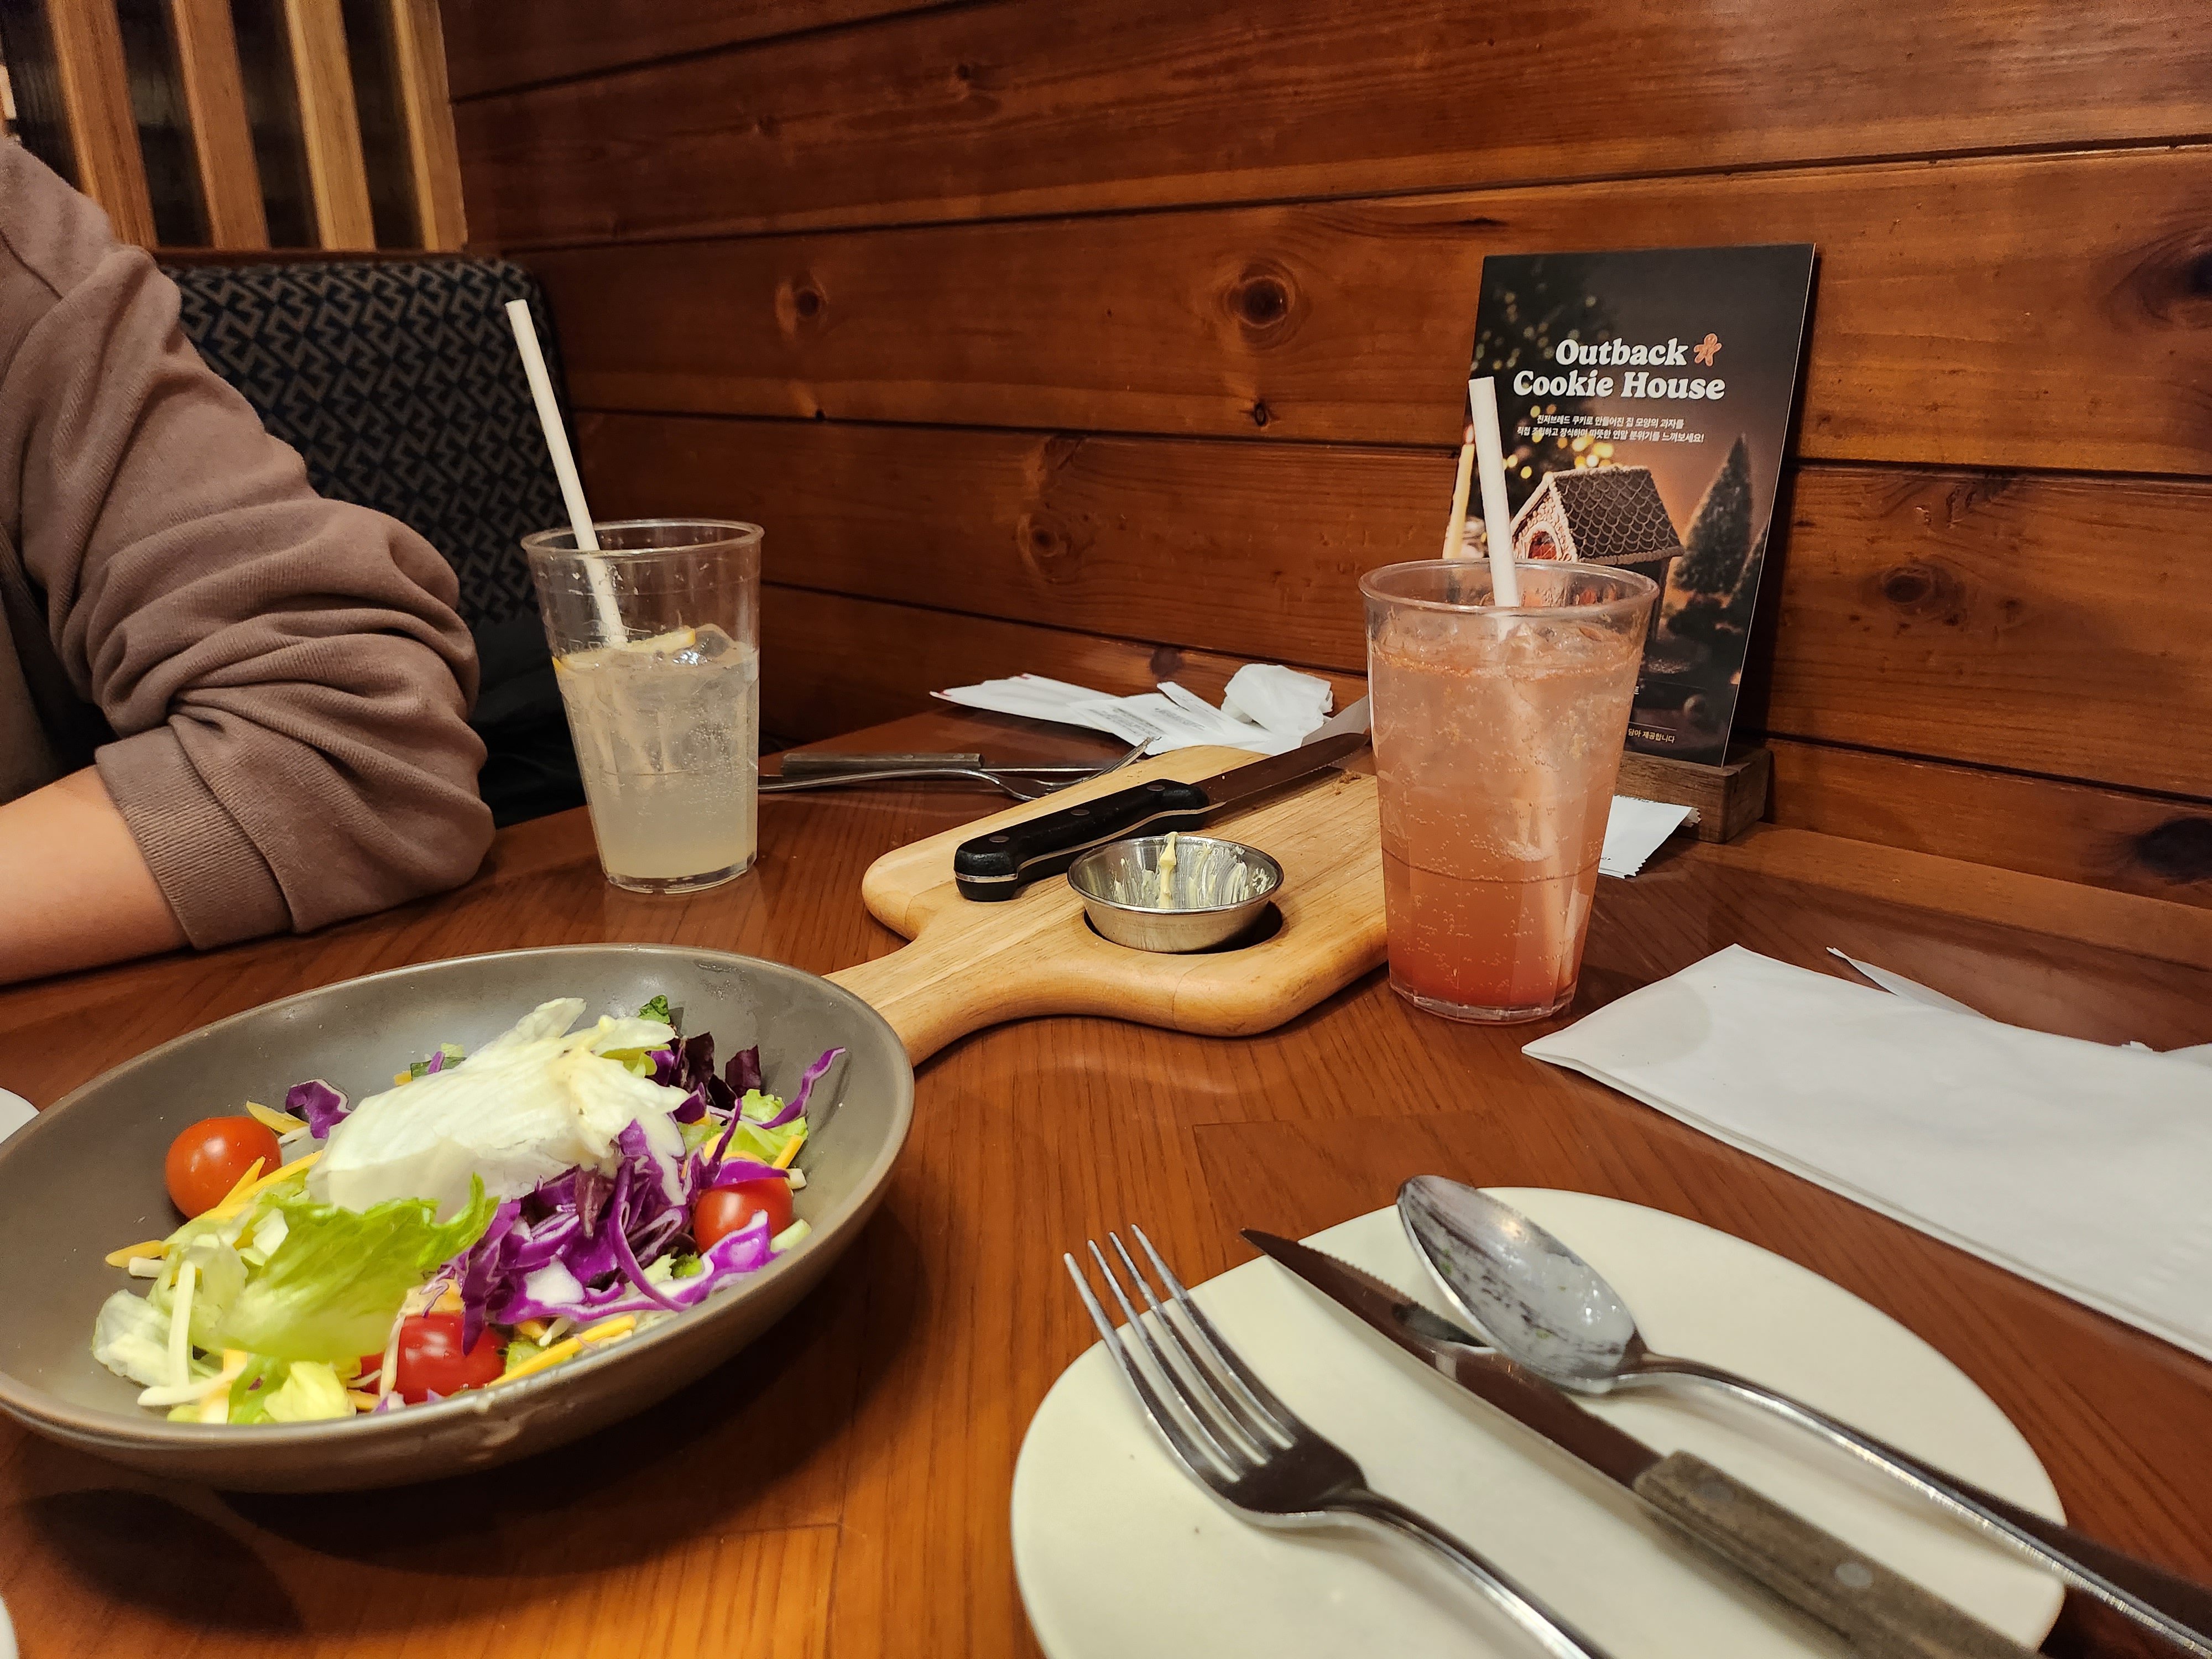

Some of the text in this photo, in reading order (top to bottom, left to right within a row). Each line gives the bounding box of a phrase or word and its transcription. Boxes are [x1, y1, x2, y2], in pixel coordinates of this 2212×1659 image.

[1556, 337, 1689, 366] Outback
[1513, 369, 1726, 400] Cookie House
[1537, 415, 1684, 429] 진저브레드 쿠키로 만들어진 집 모양의 과자를
[1517, 426, 1530, 436] 직접
[1559, 428, 1588, 438] 장식하며
[1589, 429, 1611, 440] 따뜻한
[1613, 429, 1628, 440] 연말
[1629, 430, 1660, 441] 분위기를
[1662, 432, 1704, 443] 느껴보세요!
[1628, 728, 1675, 743] 담아 제공합니다
